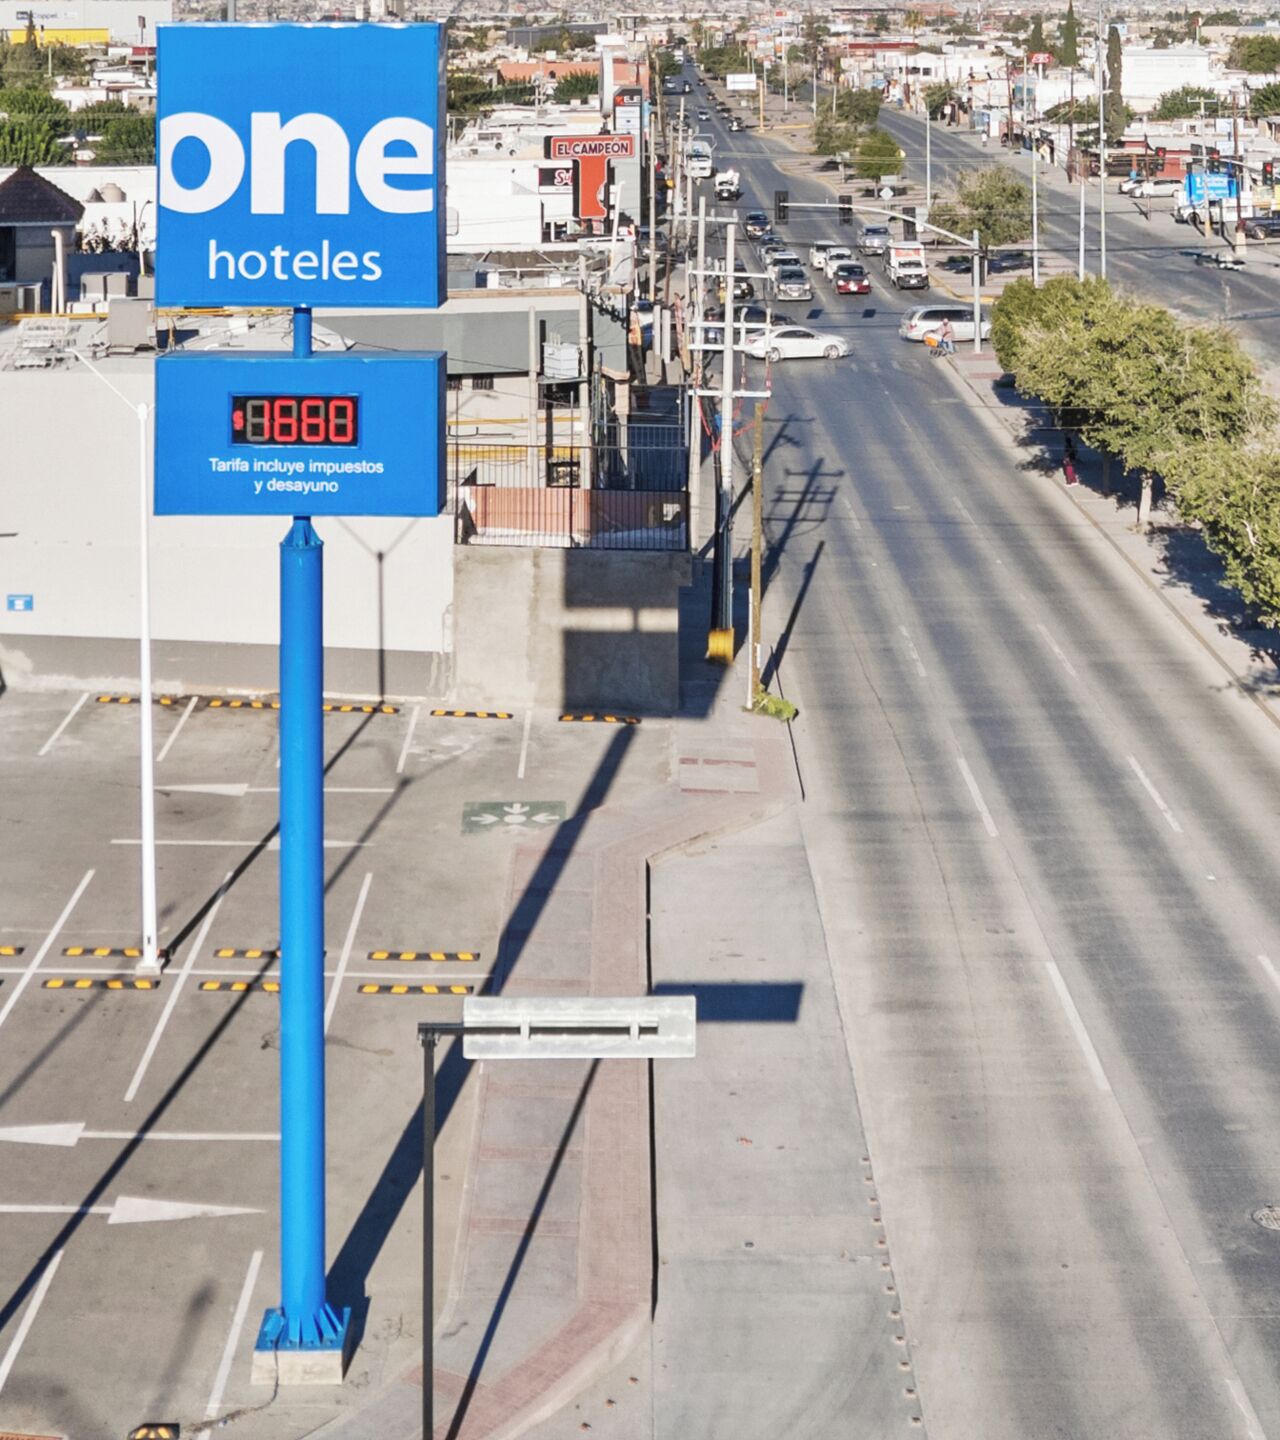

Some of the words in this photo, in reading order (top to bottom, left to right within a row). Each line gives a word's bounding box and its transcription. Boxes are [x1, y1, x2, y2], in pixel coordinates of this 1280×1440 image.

[557, 143, 570, 155] EL
[160, 112, 434, 215] one
[209, 239, 383, 281] hoteles
[209, 458, 249, 472] Tarifa
[253, 458, 305, 475] incluye
[309, 459, 384, 475] impuestos
[254, 480, 263, 494] y
[266, 478, 339, 495] desayuno
